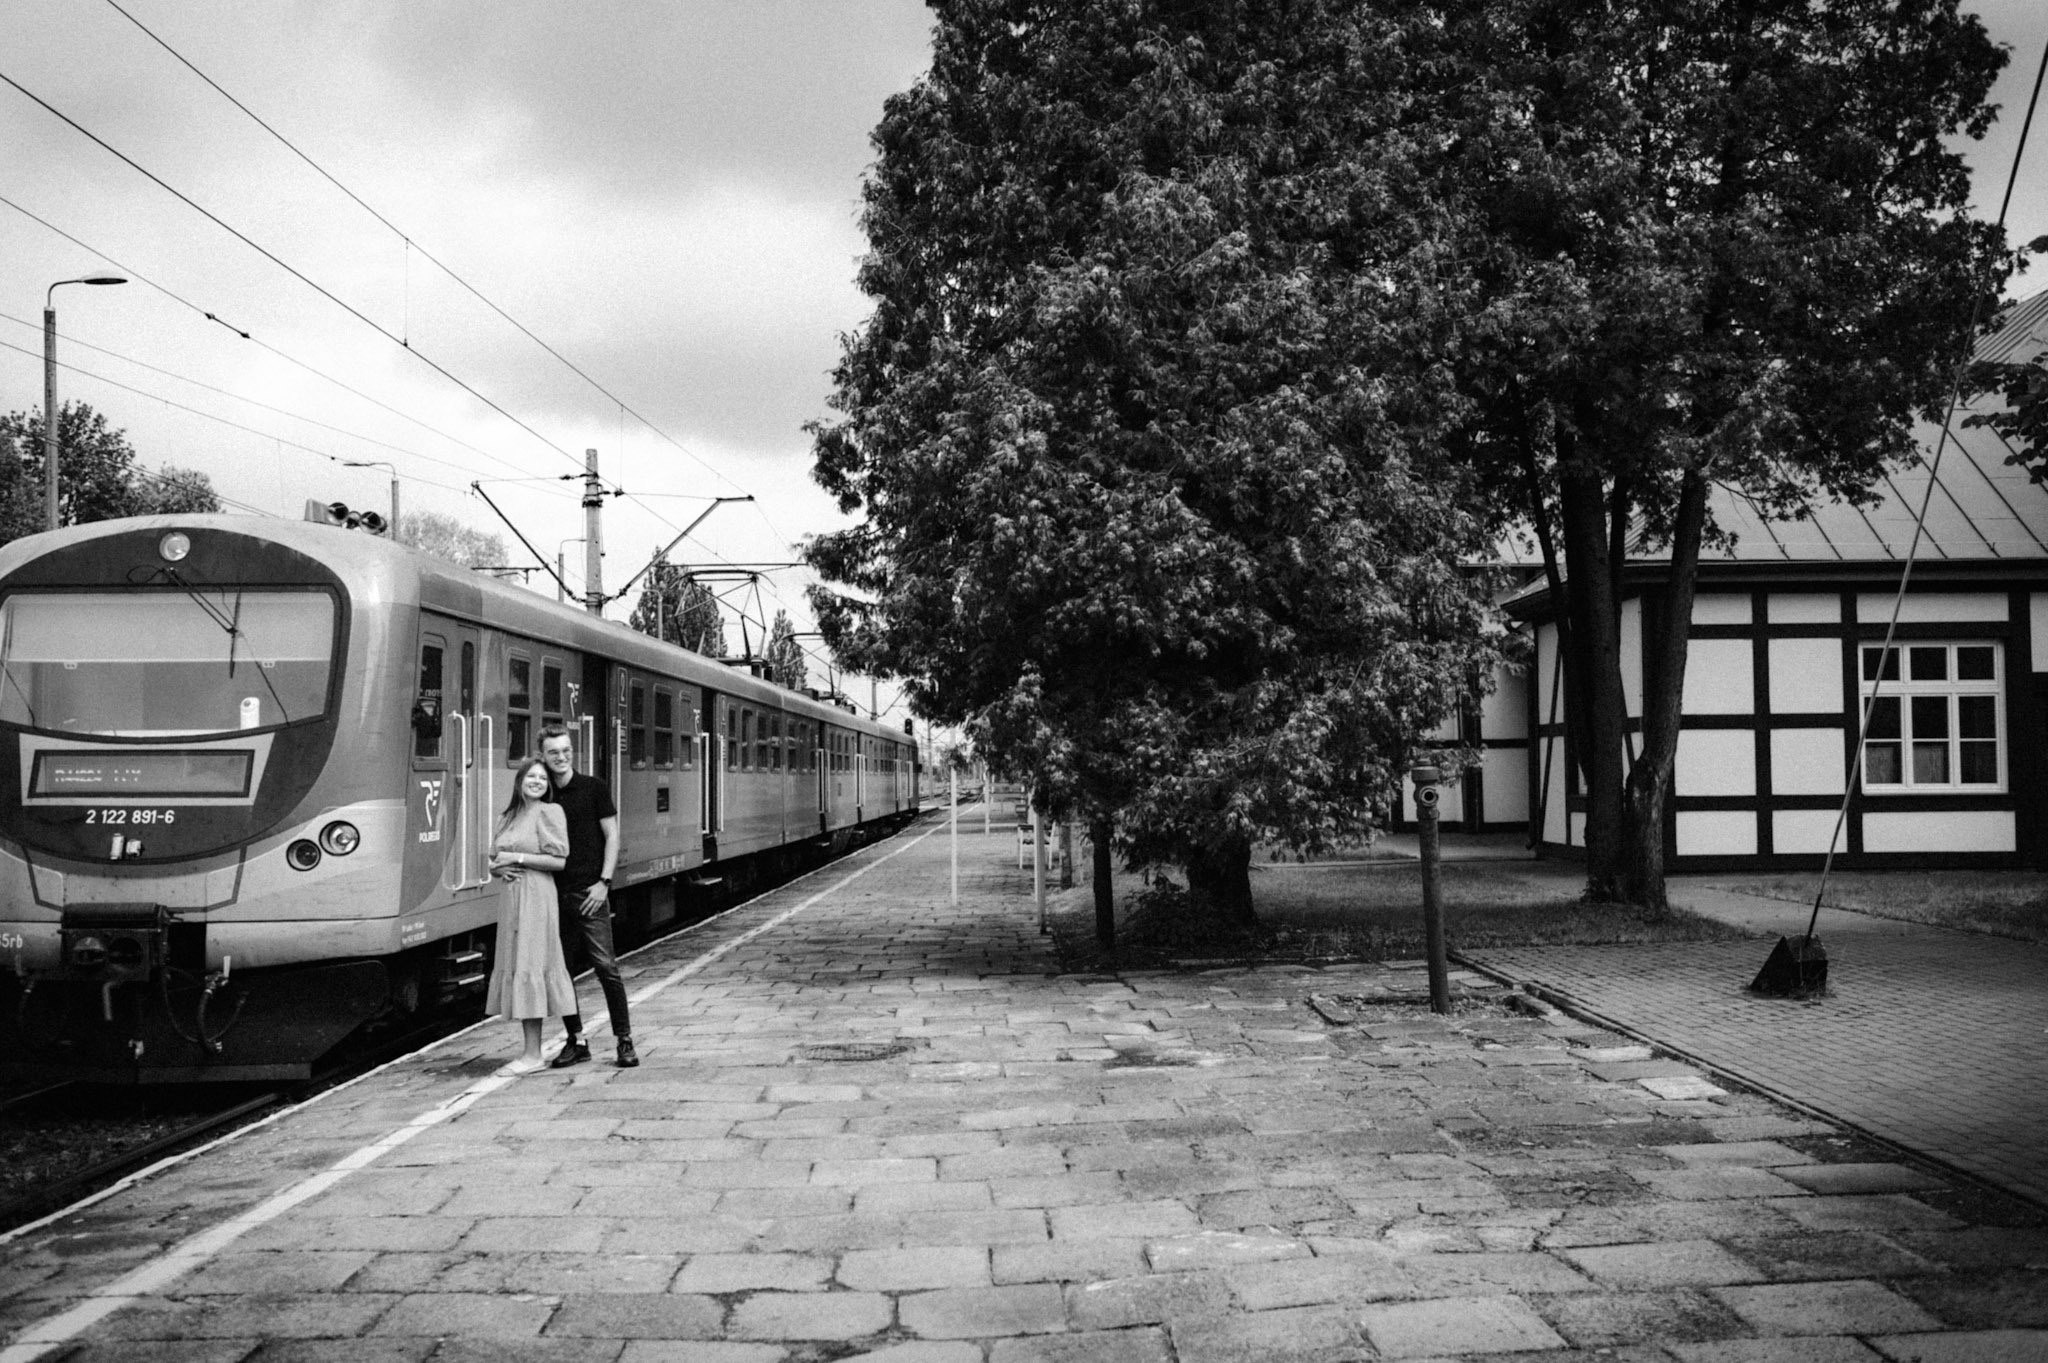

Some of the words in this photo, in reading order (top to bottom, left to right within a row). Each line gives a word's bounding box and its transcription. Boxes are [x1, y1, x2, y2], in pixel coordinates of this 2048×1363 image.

[85, 809, 97, 824] 2
[102, 809, 127, 824] 122
[131, 809, 175, 824] 891-6
[0, 933, 23, 949] 5rb
